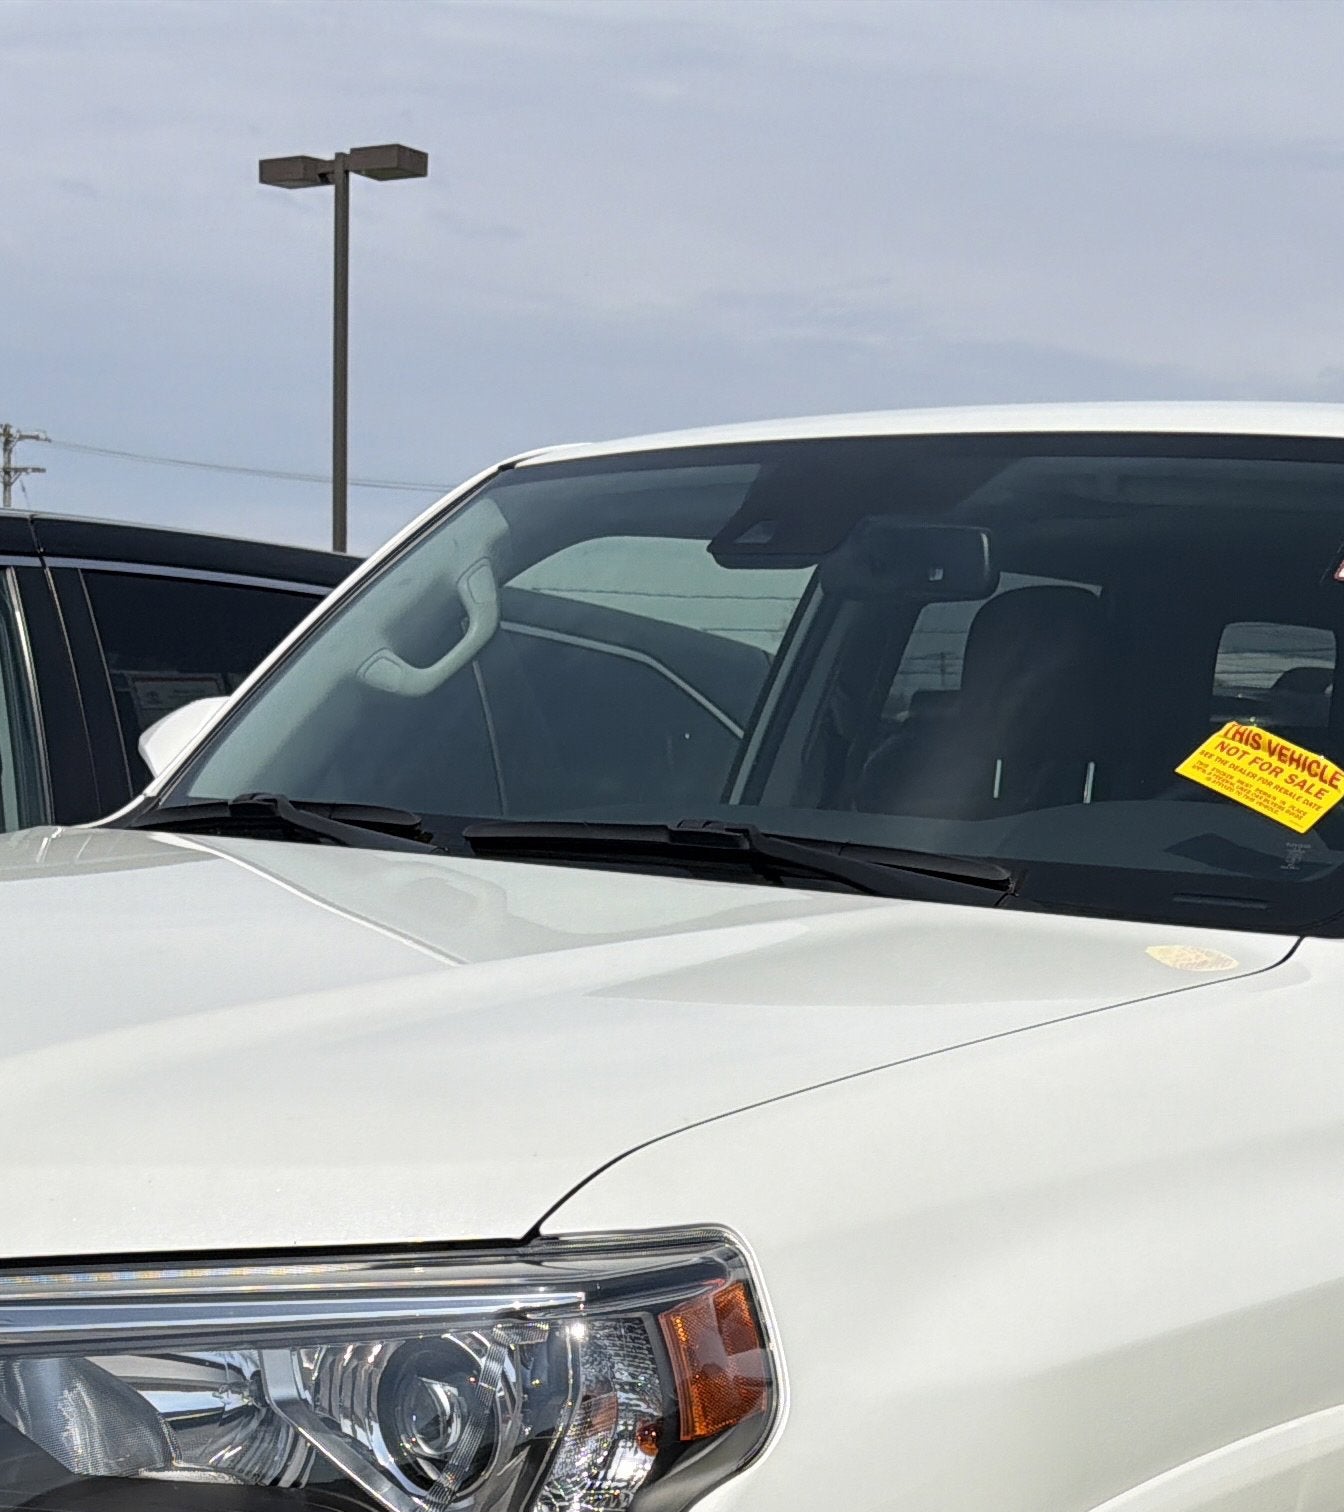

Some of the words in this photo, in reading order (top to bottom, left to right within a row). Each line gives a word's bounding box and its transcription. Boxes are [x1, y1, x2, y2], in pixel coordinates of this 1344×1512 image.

[1223, 724, 1262, 750] THIS
[1199, 750, 1213, 759] SEE
[1213, 757, 1228, 765] THE
[1228, 763, 1257, 779] DEALER
[1257, 777, 1273, 787] FOR
[1273, 785, 1302, 801] RESALE
[1302, 799, 1322, 811] DATE
[1213, 740, 1250, 761] NOT
[1247, 756, 1286, 778] FOR
[1282, 773, 1330, 799] SALE
